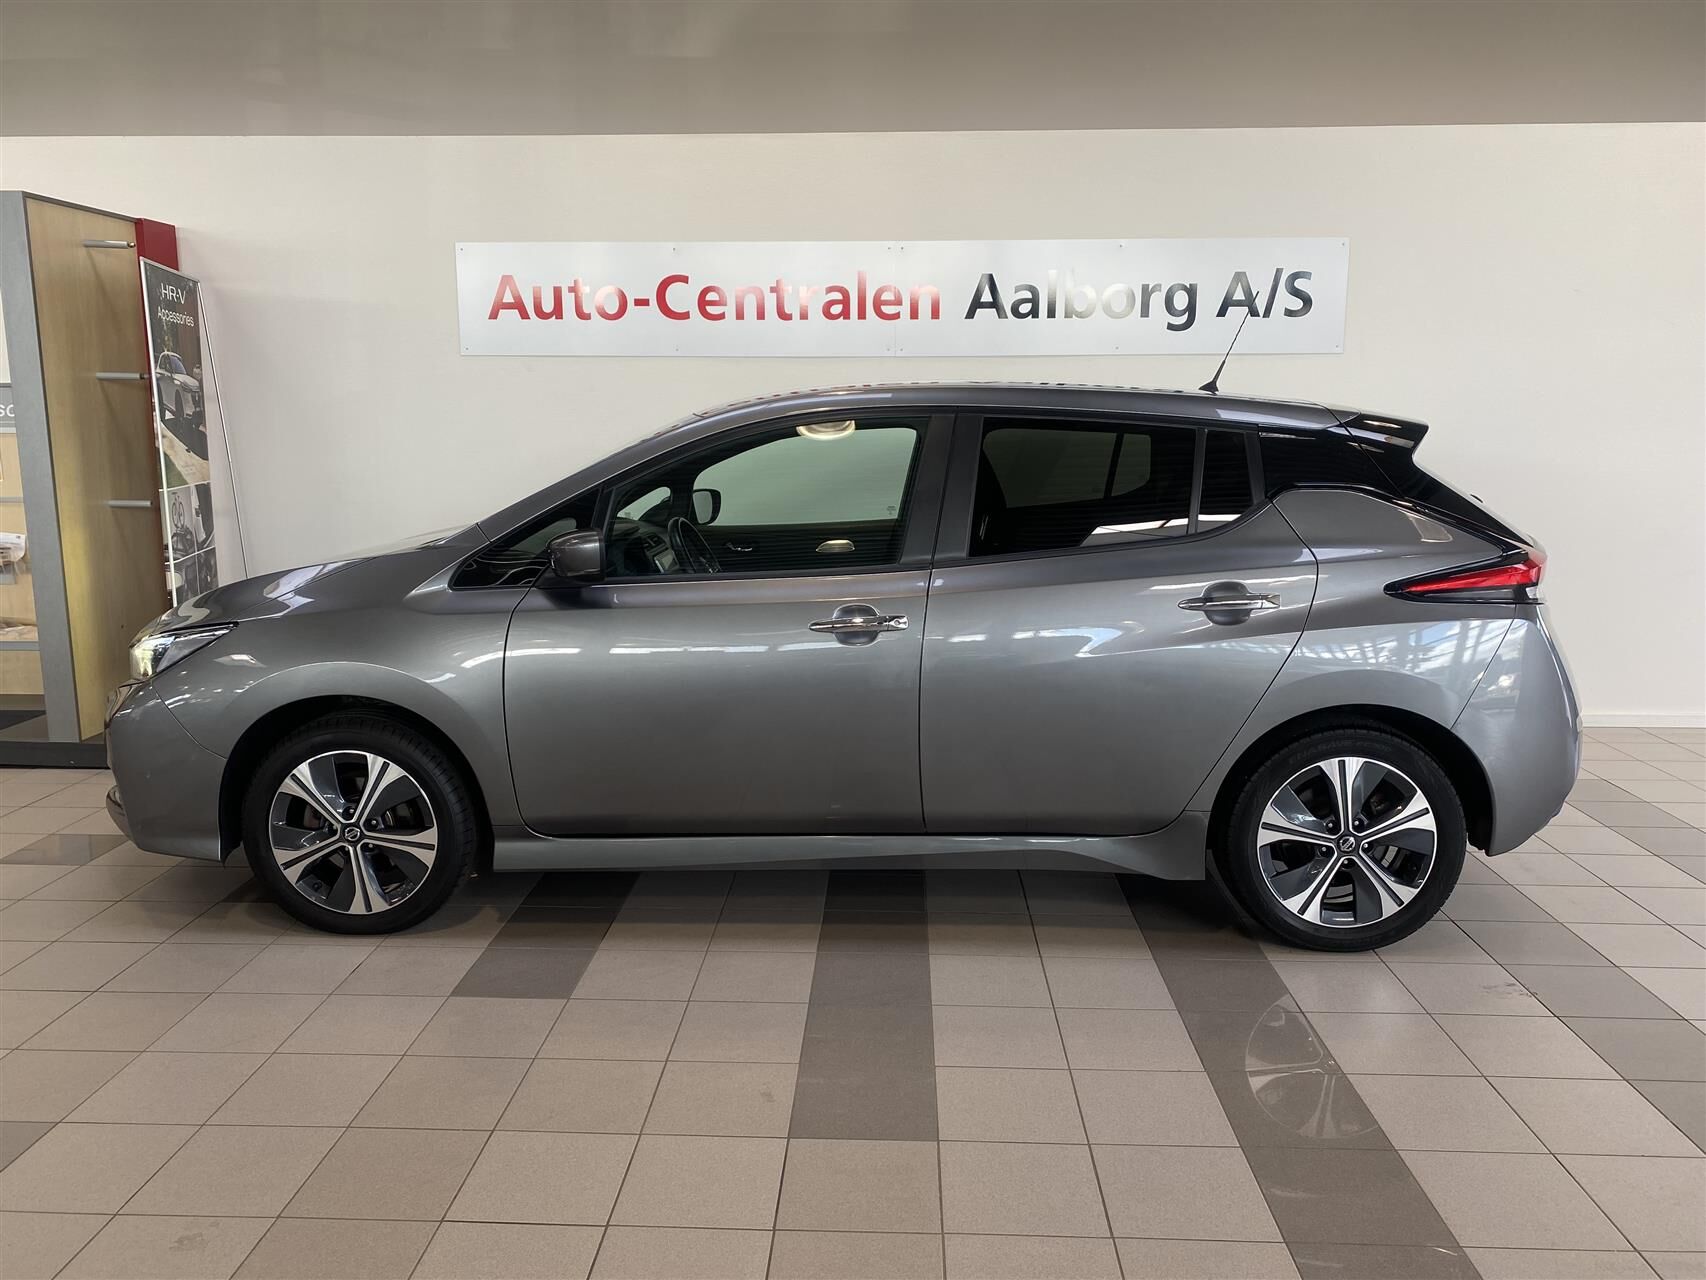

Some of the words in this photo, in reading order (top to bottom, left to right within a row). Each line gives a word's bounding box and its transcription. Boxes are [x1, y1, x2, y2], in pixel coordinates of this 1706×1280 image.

[161, 283, 185, 304] HR-V
[488, 270, 940, 321] Auto-Centralen
[964, 268, 1198, 332] Aalborg
[1216, 267, 1313, 319] A/S
[157, 306, 194, 326] Accessories
